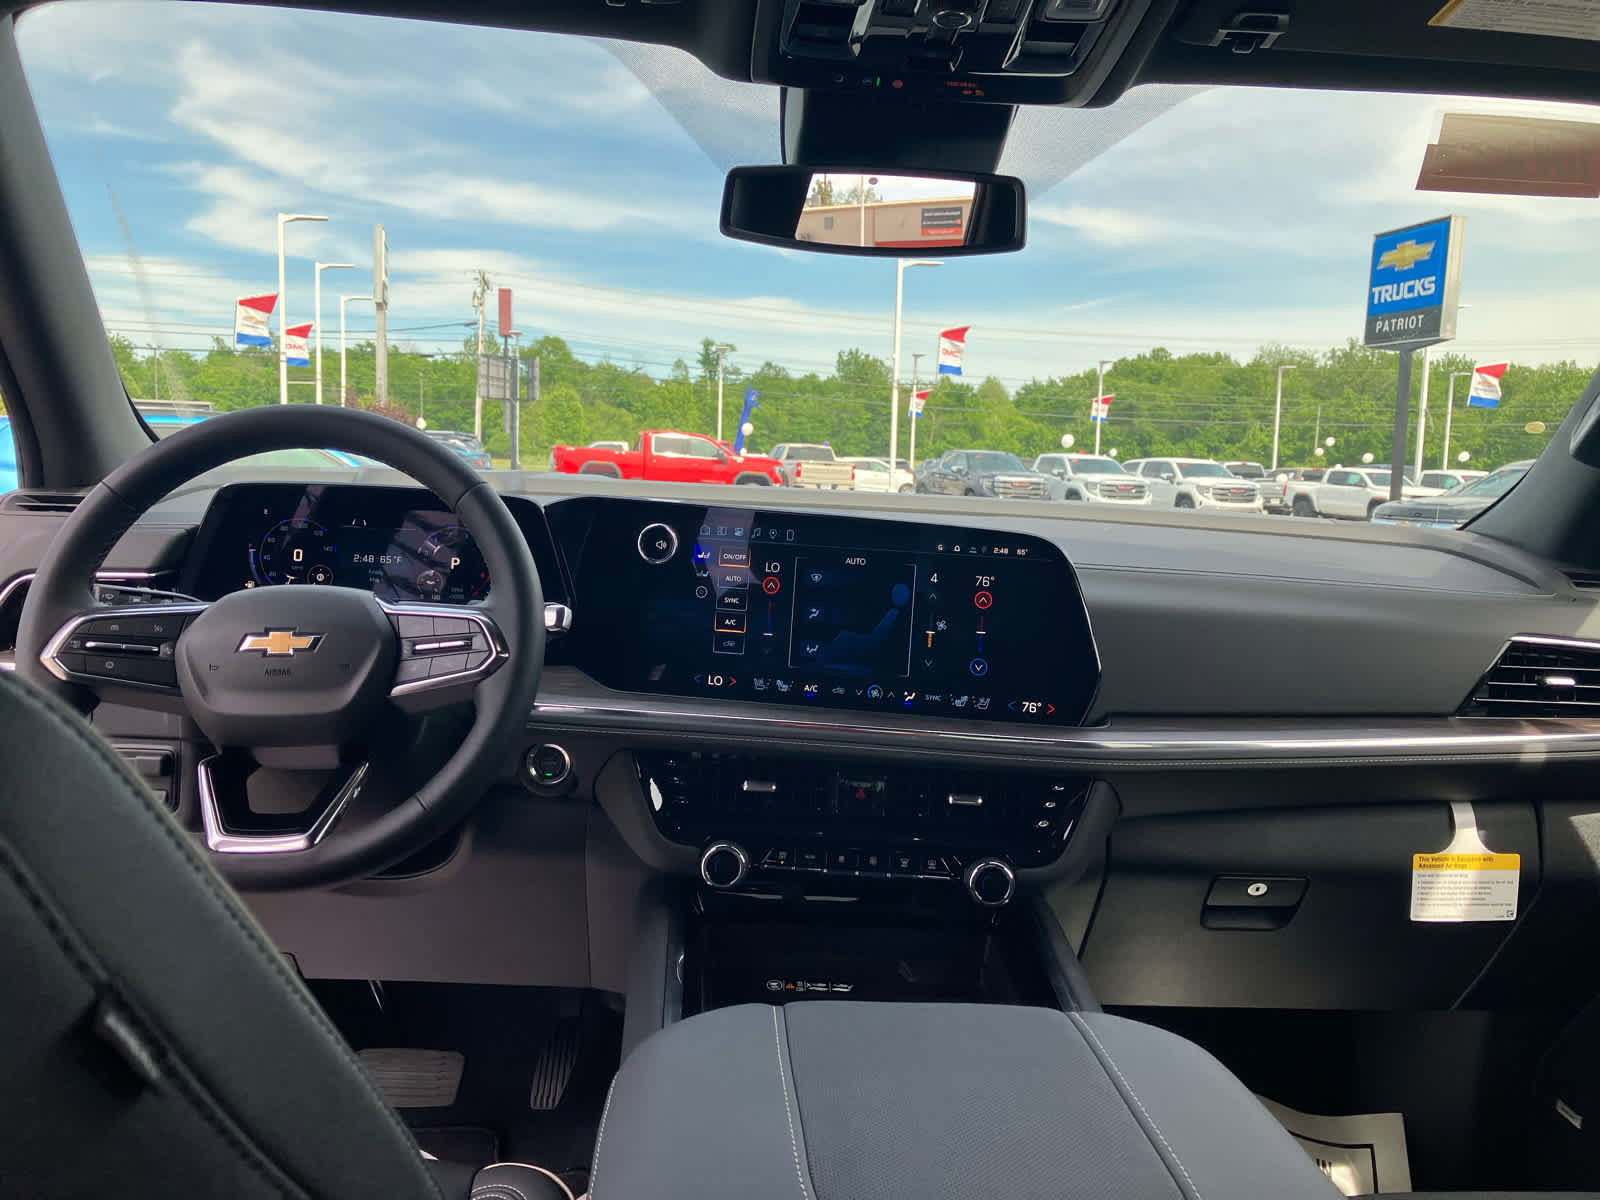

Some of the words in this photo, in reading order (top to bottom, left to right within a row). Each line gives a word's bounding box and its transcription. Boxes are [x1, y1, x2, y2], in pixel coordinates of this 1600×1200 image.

[1372, 276, 1436, 304] TRUCKS
[1376, 315, 1424, 333] PATRIOT
[292, 548, 303, 562] 0
[993, 547, 1009, 555] 2:48
[353, 554, 374, 564] 2:48
[724, 553, 747, 561] ON/OFF
[846, 557, 867, 566] AUTO
[450, 557, 461, 570] P
[766, 562, 780, 573] LO
[930, 573, 938, 583] 4
[976, 576, 995, 586] 76°
[708, 675, 723, 687] LO
[804, 684, 818, 693] A/C
[1021, 702, 1042, 713] 76°
